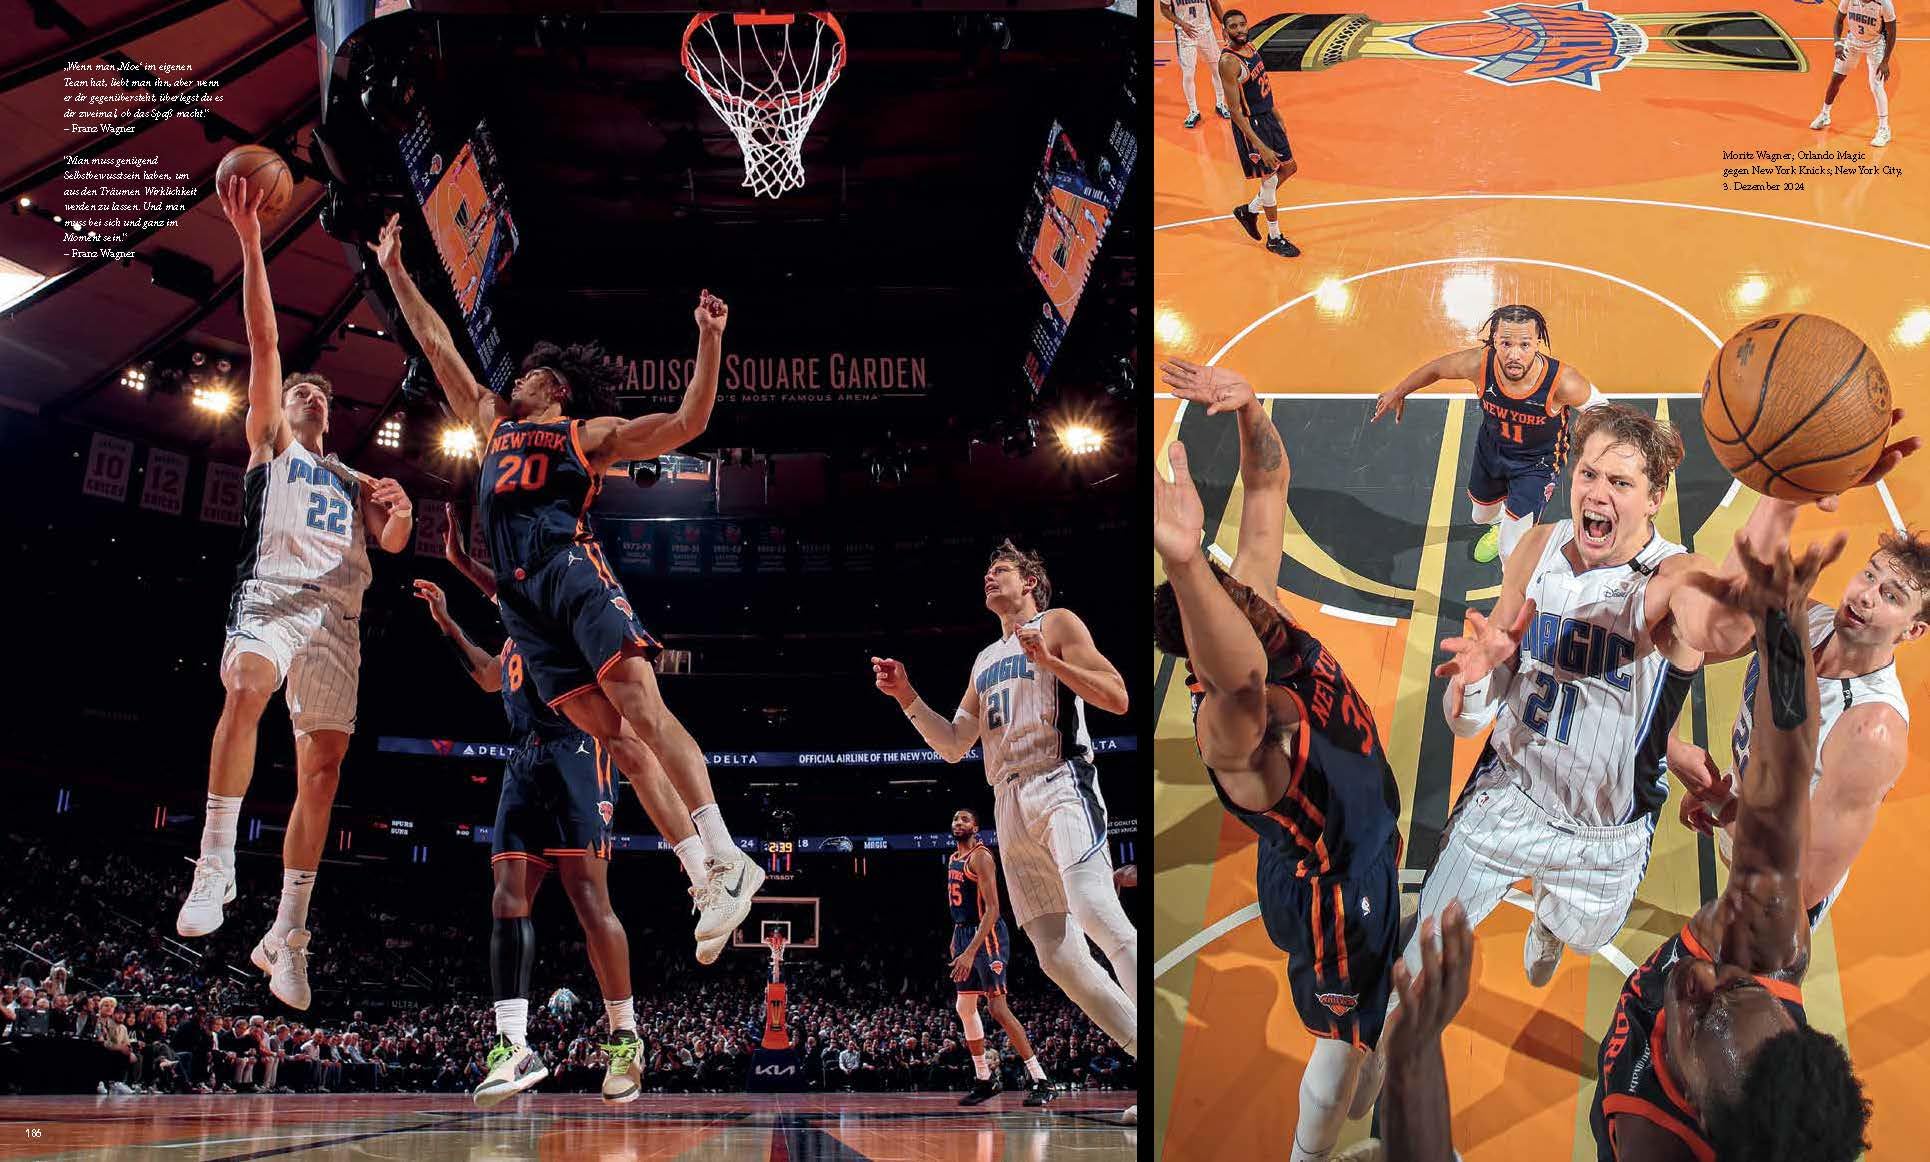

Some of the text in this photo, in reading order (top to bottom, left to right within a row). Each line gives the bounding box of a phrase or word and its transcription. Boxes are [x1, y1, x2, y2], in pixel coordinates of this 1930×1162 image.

[1848, 12, 1877, 27] MAGIC
[1858, 25, 1865, 35] 3
[602, 353, 928, 391] ADISO SQUARE GARDEN
[1483, 400, 1547, 425] NEW YORK
[491, 430, 566, 455] NEW YORK
[1501, 421, 1523, 444] 11
[92, 453, 123, 479] 10
[495, 453, 549, 494] 20
[153, 466, 178, 495] 12
[307, 492, 348, 535] 22
[509, 654, 523, 692] 8
[976, 654, 1034, 693] MAGIC
[988, 688, 1010, 730] 21
[1522, 672, 1579, 745] 21
[479, 746, 515, 757] DELT
[799, 754, 835, 764] OFFICIAL
[836, 753, 869, 763] AIRLINE
[870, 753, 881, 762] OF
[883, 752, 899, 762] THE
[901, 751, 920, 761] NEW
[1092, 740, 1117, 750] LTA
[713, 755, 758, 764] DELTA
[740, 839, 754, 848] 24
[864, 841, 888, 849] MAGIC
